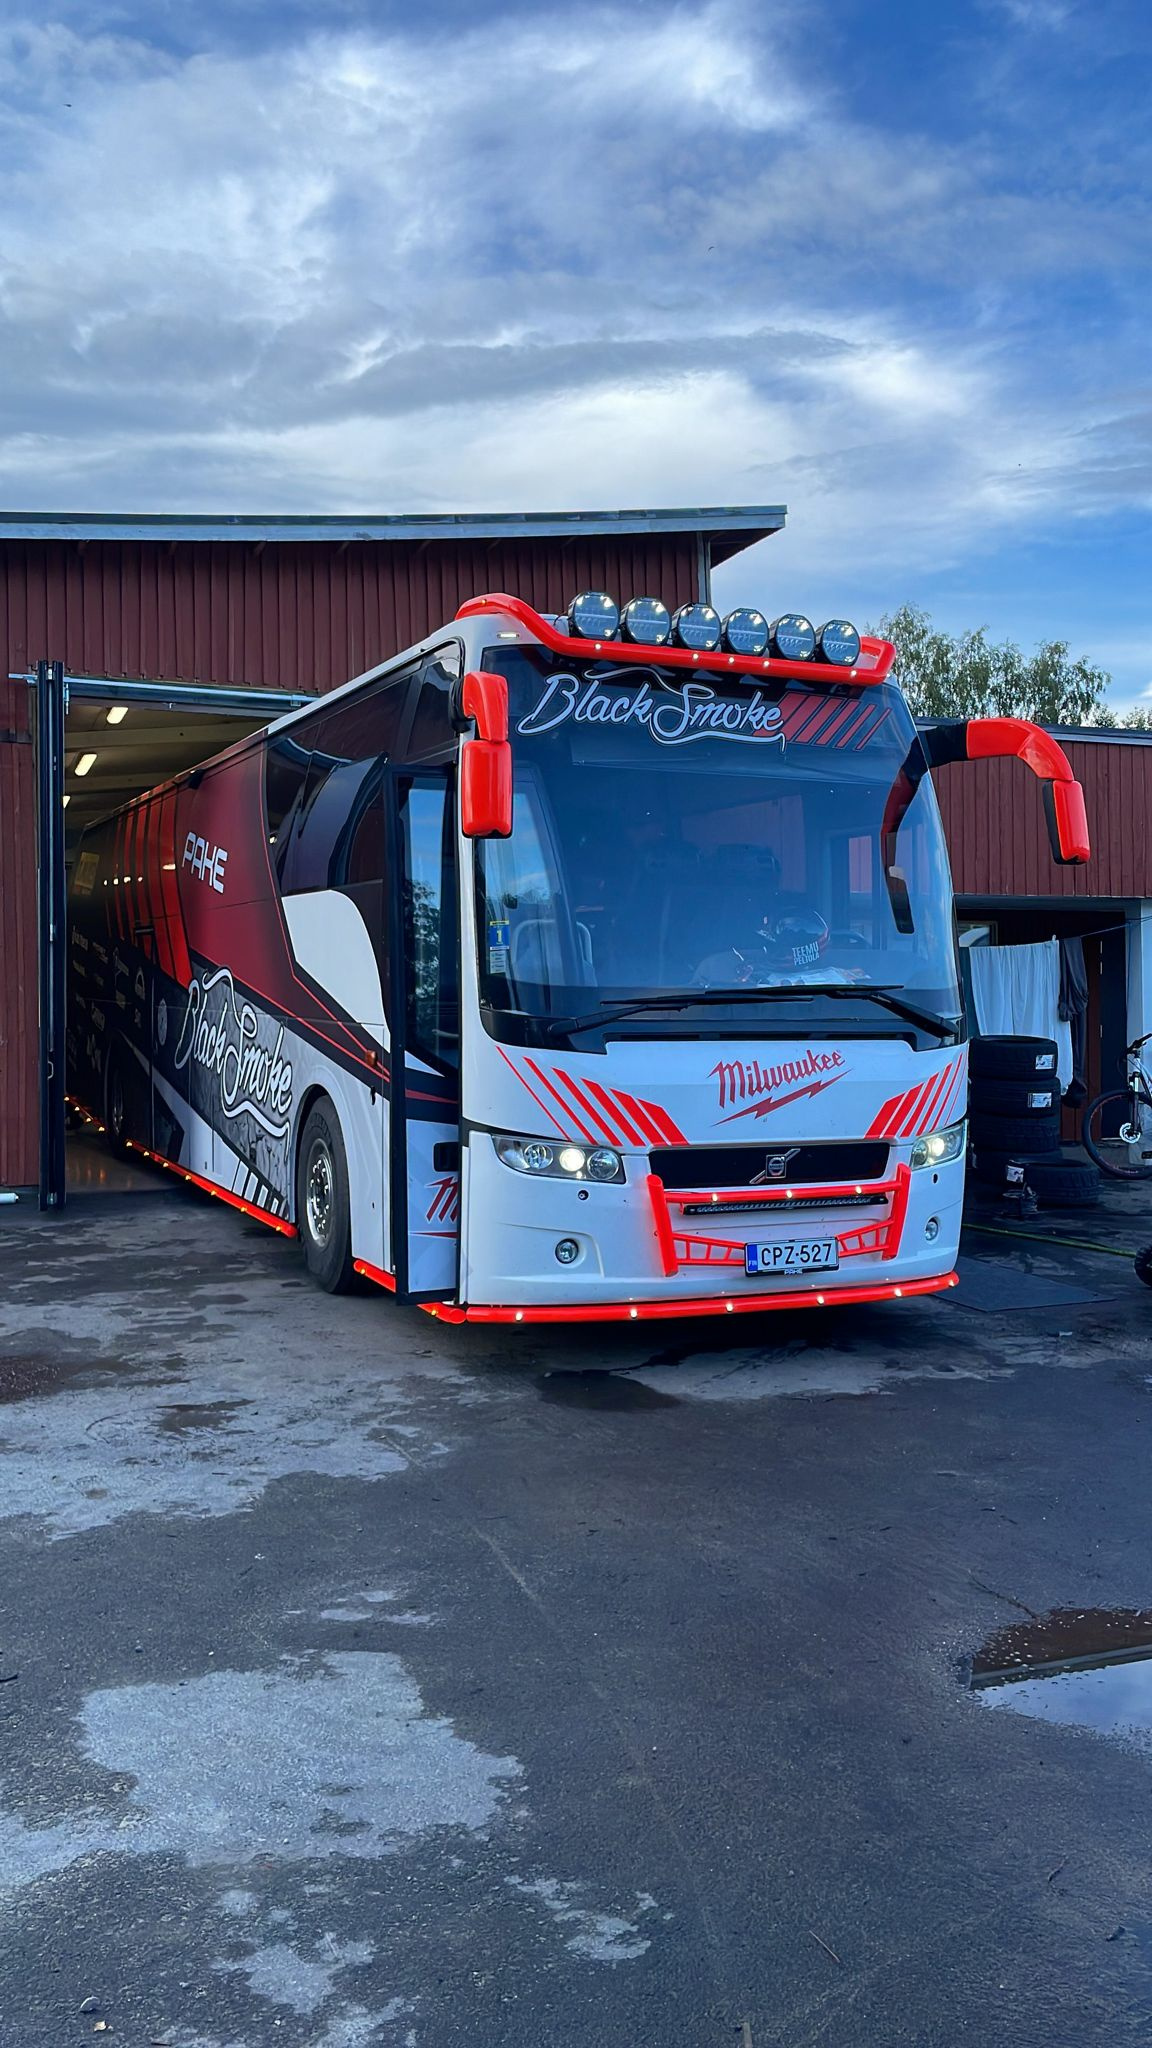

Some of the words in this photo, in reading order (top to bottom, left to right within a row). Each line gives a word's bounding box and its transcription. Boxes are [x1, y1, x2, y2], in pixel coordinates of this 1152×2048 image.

[518, 673, 653, 734] Black
[650, 680, 785, 751] Smoke
[181, 831, 228, 894] PAHE
[791, 941, 819, 958] TEEMU
[175, 979, 227, 1074] Black
[221, 1003, 293, 1137] Smoke
[706, 1049, 846, 1109] Milwaukee
[761, 1243, 832, 1266] CPZ-527
